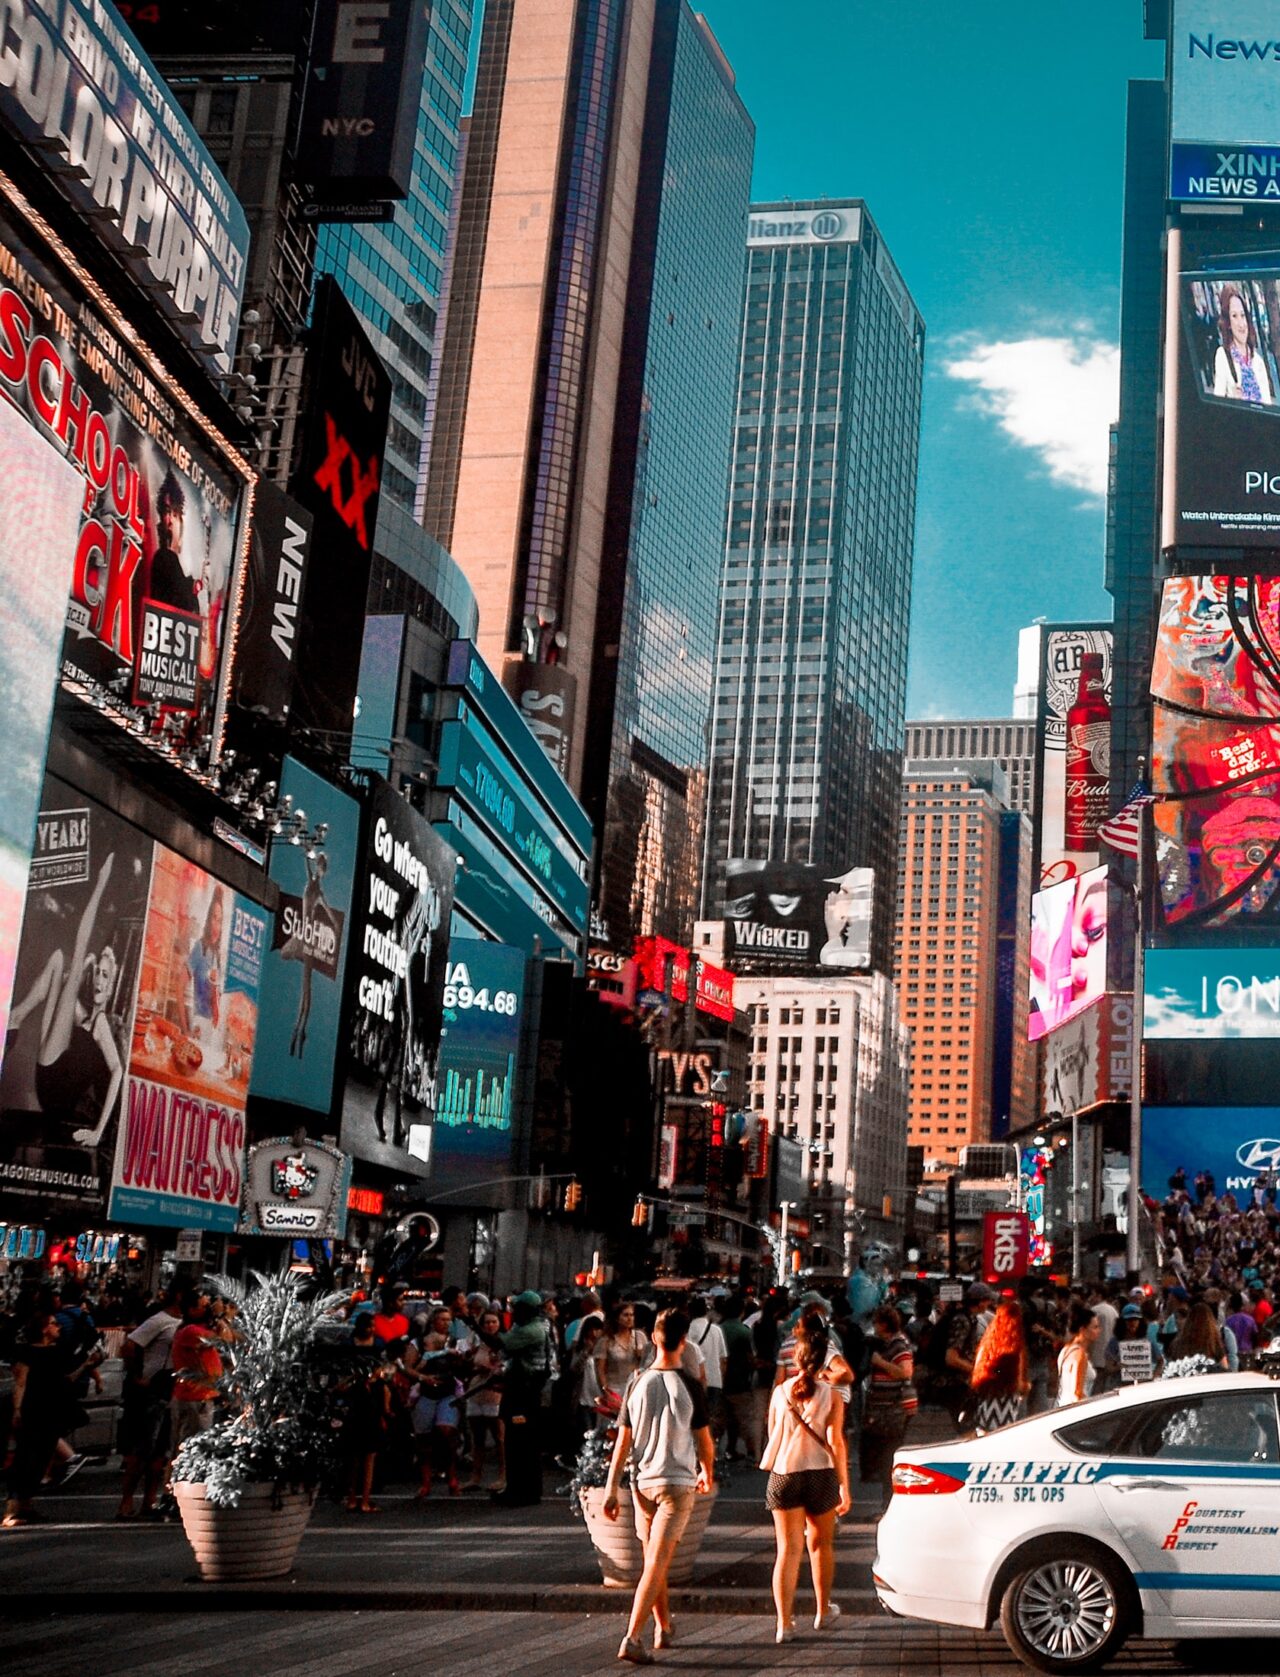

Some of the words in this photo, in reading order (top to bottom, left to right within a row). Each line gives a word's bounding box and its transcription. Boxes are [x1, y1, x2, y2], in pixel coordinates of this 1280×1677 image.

[322, 118, 375, 137] NYC
[1188, 177, 1258, 195] NEWS
[123, 154, 238, 375] PURPLE
[53, 302, 78, 349] THE
[79, 331, 148, 428] EMPOWERING
[147, 410, 190, 476] MESSAGE
[79, 302, 118, 361] ANDREW
[117, 341, 143, 388] LLOYD
[143, 379, 175, 429] WEBBER
[341, 335, 377, 412] JVC
[0, 289, 145, 544] SCHOOL
[1181, 511, 1209, 521] Watch
[1210, 511, 1262, 522] Unbreakable
[72, 514, 143, 665] CK
[271, 516, 307, 662] NEW
[143, 611, 199, 660] BEST
[140, 652, 197, 686] MUSICAL!
[1228, 750, 1255, 768] day
[38, 818, 87, 850] YEARS
[375, 817, 393, 863] Go
[394, 840, 430, 895] where
[368, 872, 400, 920] your
[234, 908, 265, 948] BEST
[362, 923, 408, 979] routine
[358, 975, 395, 1022] can't.
[122, 1078, 243, 1205] WAITRESS
[994, 1217, 1022, 1272] tkts
[966, 1461, 1101, 1484] TRAFFIC
[1013, 1487, 1036, 1502] SPL
[1041, 1487, 1065, 1502] OPS
[1173, 1518, 1279, 1536] PROFESSIONALISM
[1183, 1501, 1246, 1518] COURTESY
[1162, 1535, 1218, 1551] RESPECT
